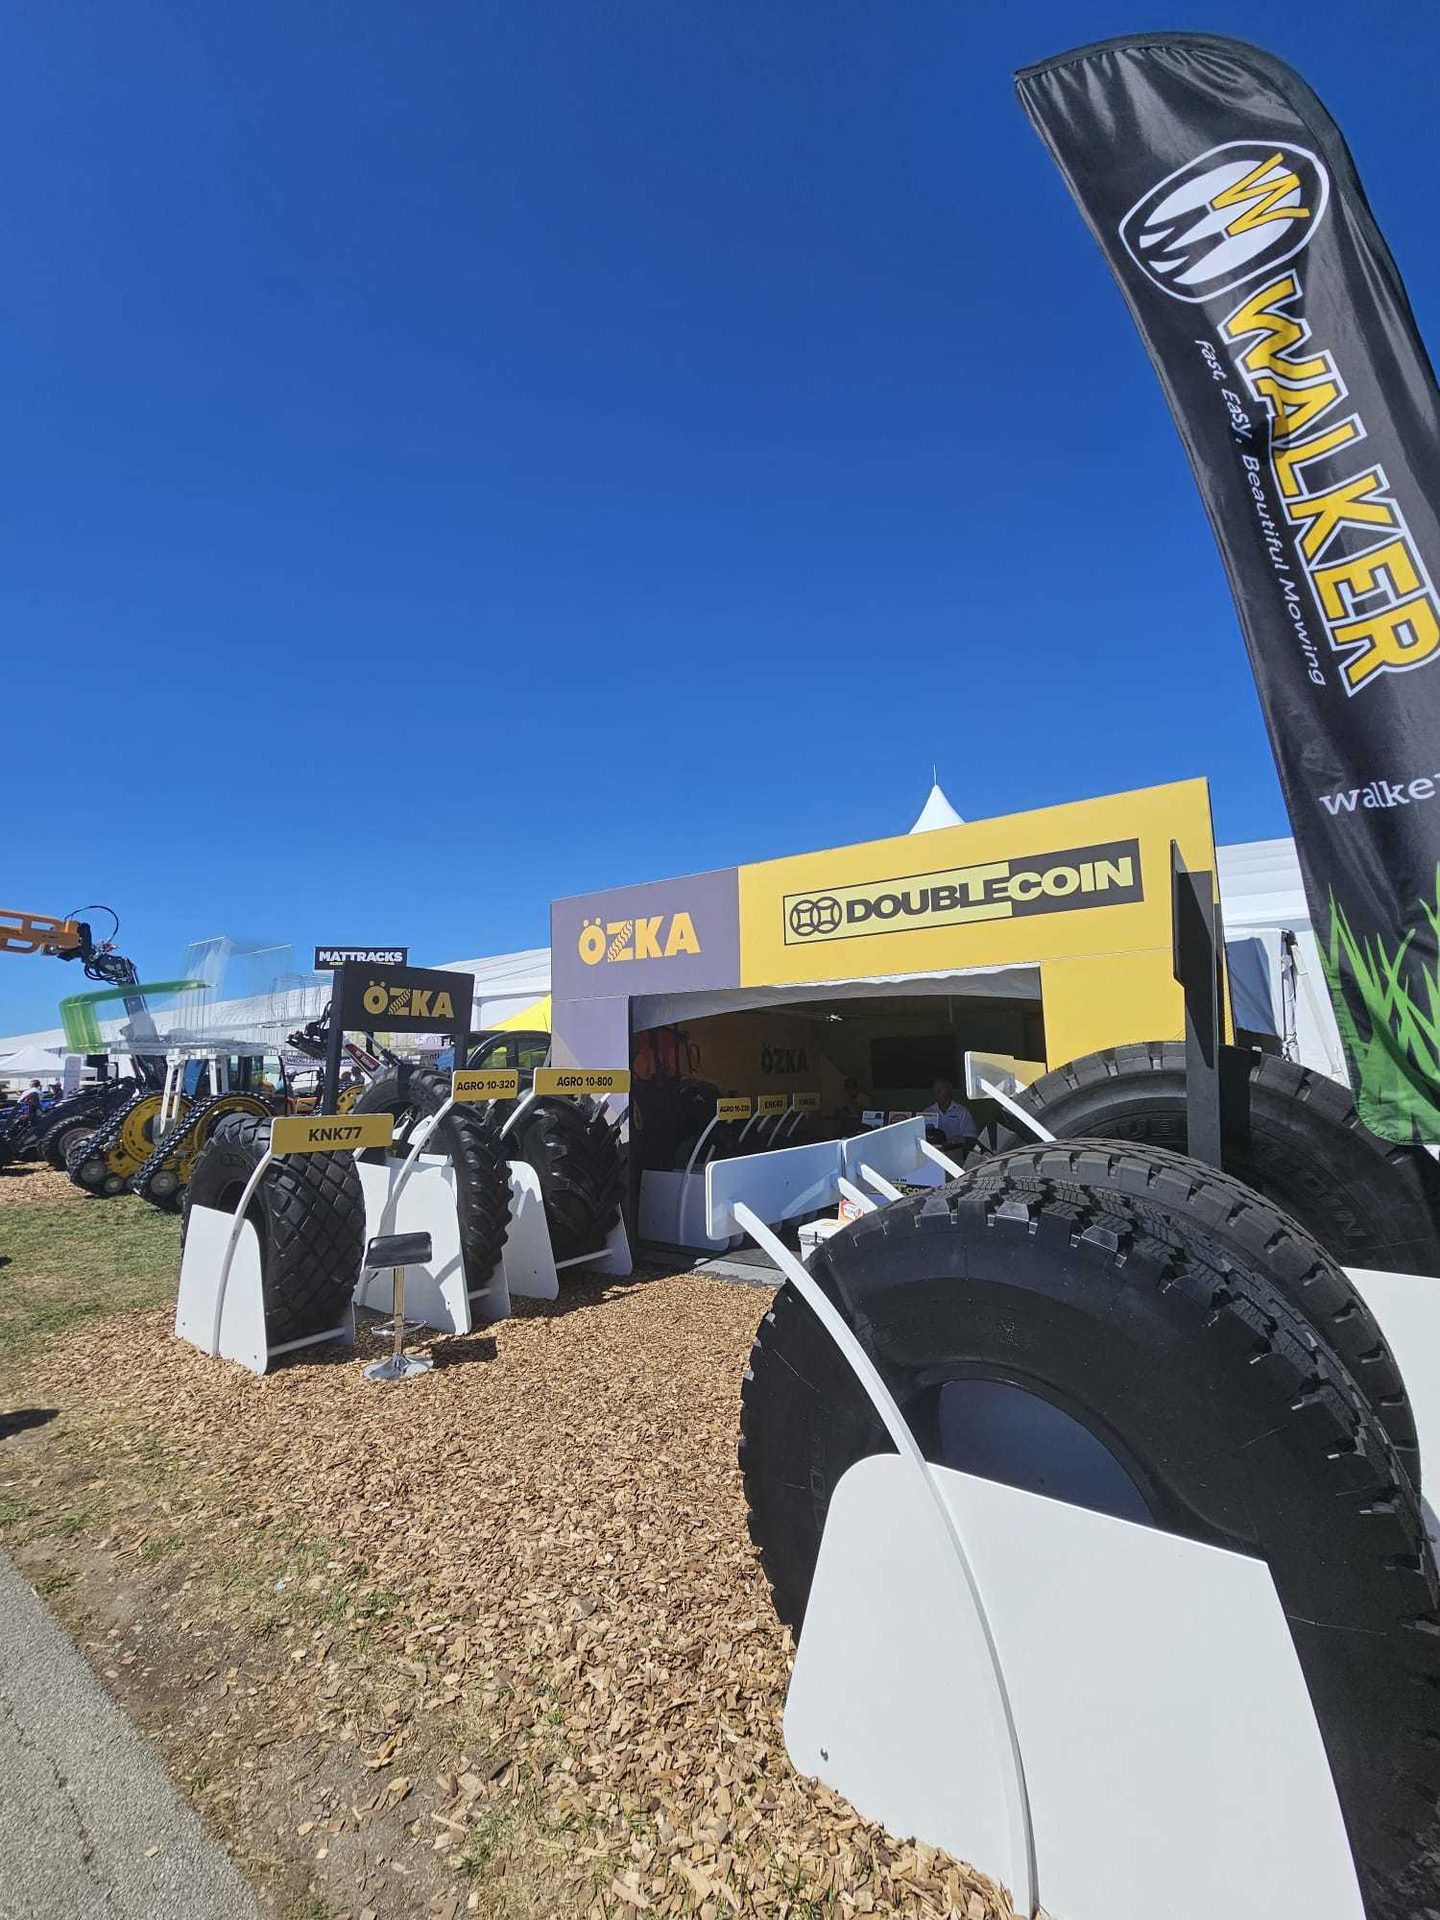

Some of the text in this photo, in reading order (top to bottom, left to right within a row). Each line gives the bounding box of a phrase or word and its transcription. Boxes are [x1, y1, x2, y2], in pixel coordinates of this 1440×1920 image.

[1217, 269, 1440, 697] WALKER
[1221, 388, 1253, 444] Easy,
[1241, 454, 1290, 571] Beautiful
[1279, 577, 1327, 686] Mowing
[845, 857, 1134, 924] DOUBLECOIN
[578, 911, 701, 965] ÖZKA
[319, 951, 403, 962] MATTRACKS
[363, 980, 455, 1019] ÖZKA
[761, 1043, 809, 1075] ÖZKA
[457, 1080, 515, 1091] AGRO 10-320
[556, 1076, 612, 1087] AGRO 10-800
[308, 1126, 363, 1142] KNK77
